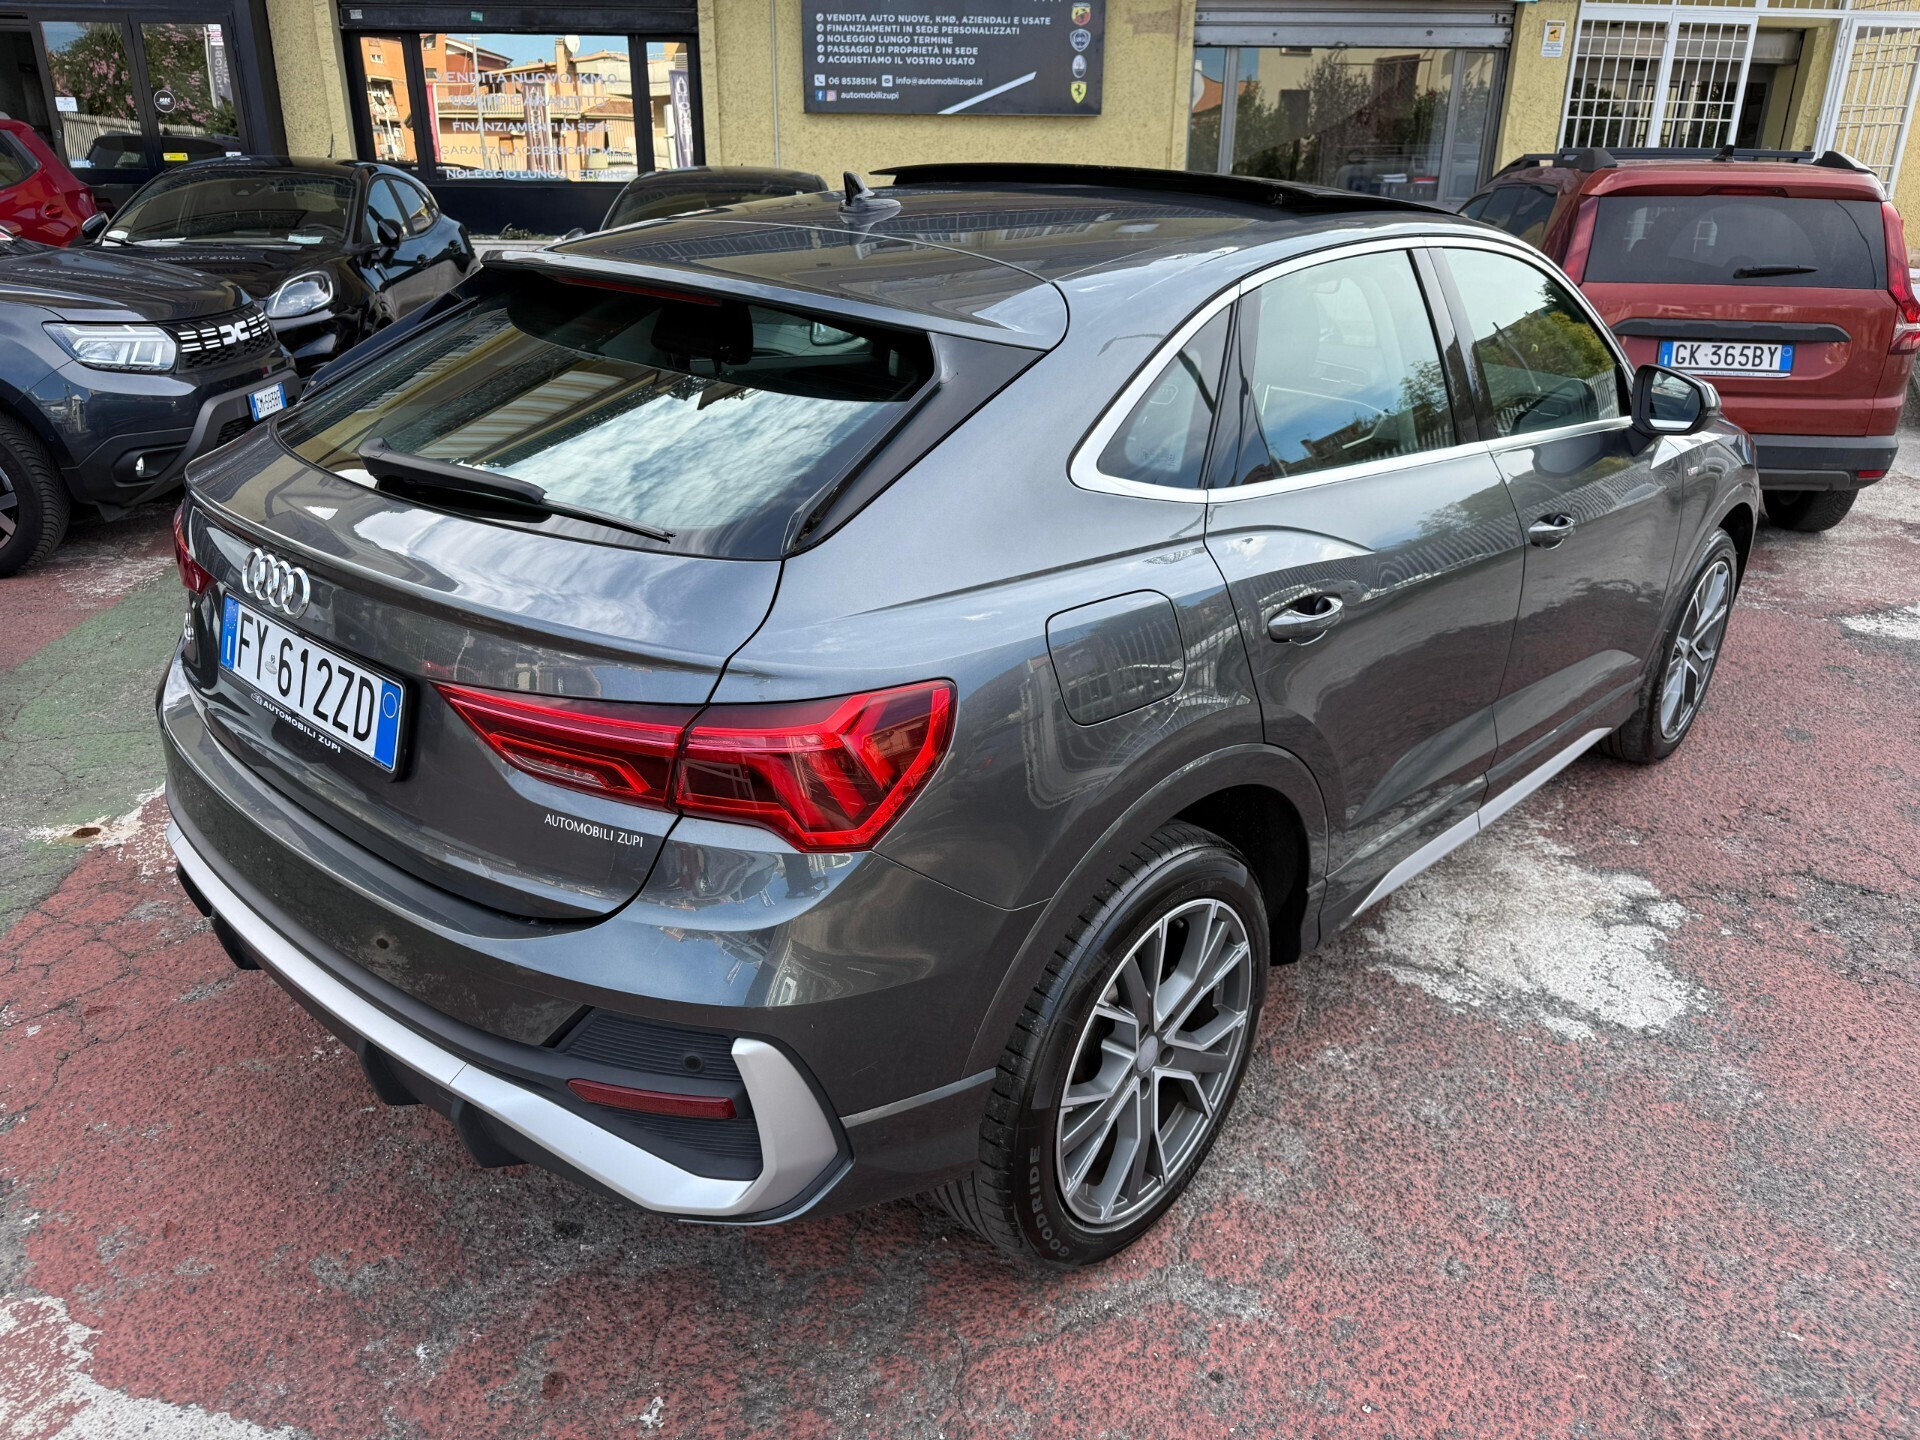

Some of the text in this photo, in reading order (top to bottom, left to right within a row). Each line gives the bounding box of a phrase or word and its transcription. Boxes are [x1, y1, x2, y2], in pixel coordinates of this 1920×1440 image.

[826, 13, 867, 22] VENDITA
[870, 14, 896, 23] AUTO
[898, 15, 933, 24] NUOVE,
[962, 16, 1011, 25] AZIENDALI
[1013, 16, 1020, 25] E
[1022, 17, 1051, 26] USATE
[826, 24, 1020, 35] FINANZIAMENTI IN SEDE PERSONALIZZATI
[826, 34, 953, 45] NOLEGGIO LUNGO TERMINE
[827, 45, 979, 55] PASSAGGI DI PROPRIETÀ IN SEDE
[827, 55, 976, 65] ACQUISTIAMO IL VOSTRO USATO
[434, 71, 508, 84] VENDITA
[828, 77, 840, 85] 06
[840, 90, 900, 100] automobilizupi
[452, 121, 559, 133] FINANZIAMENTI
[446, 168, 517, 180] NOLEGGIO
[262, 700, 341, 754] AUTOMOBILI ZUPI
[544, 813, 643, 848] AUTOMOBILI ZUPI
[1029, 1145, 1070, 1257] GOODRIDE
